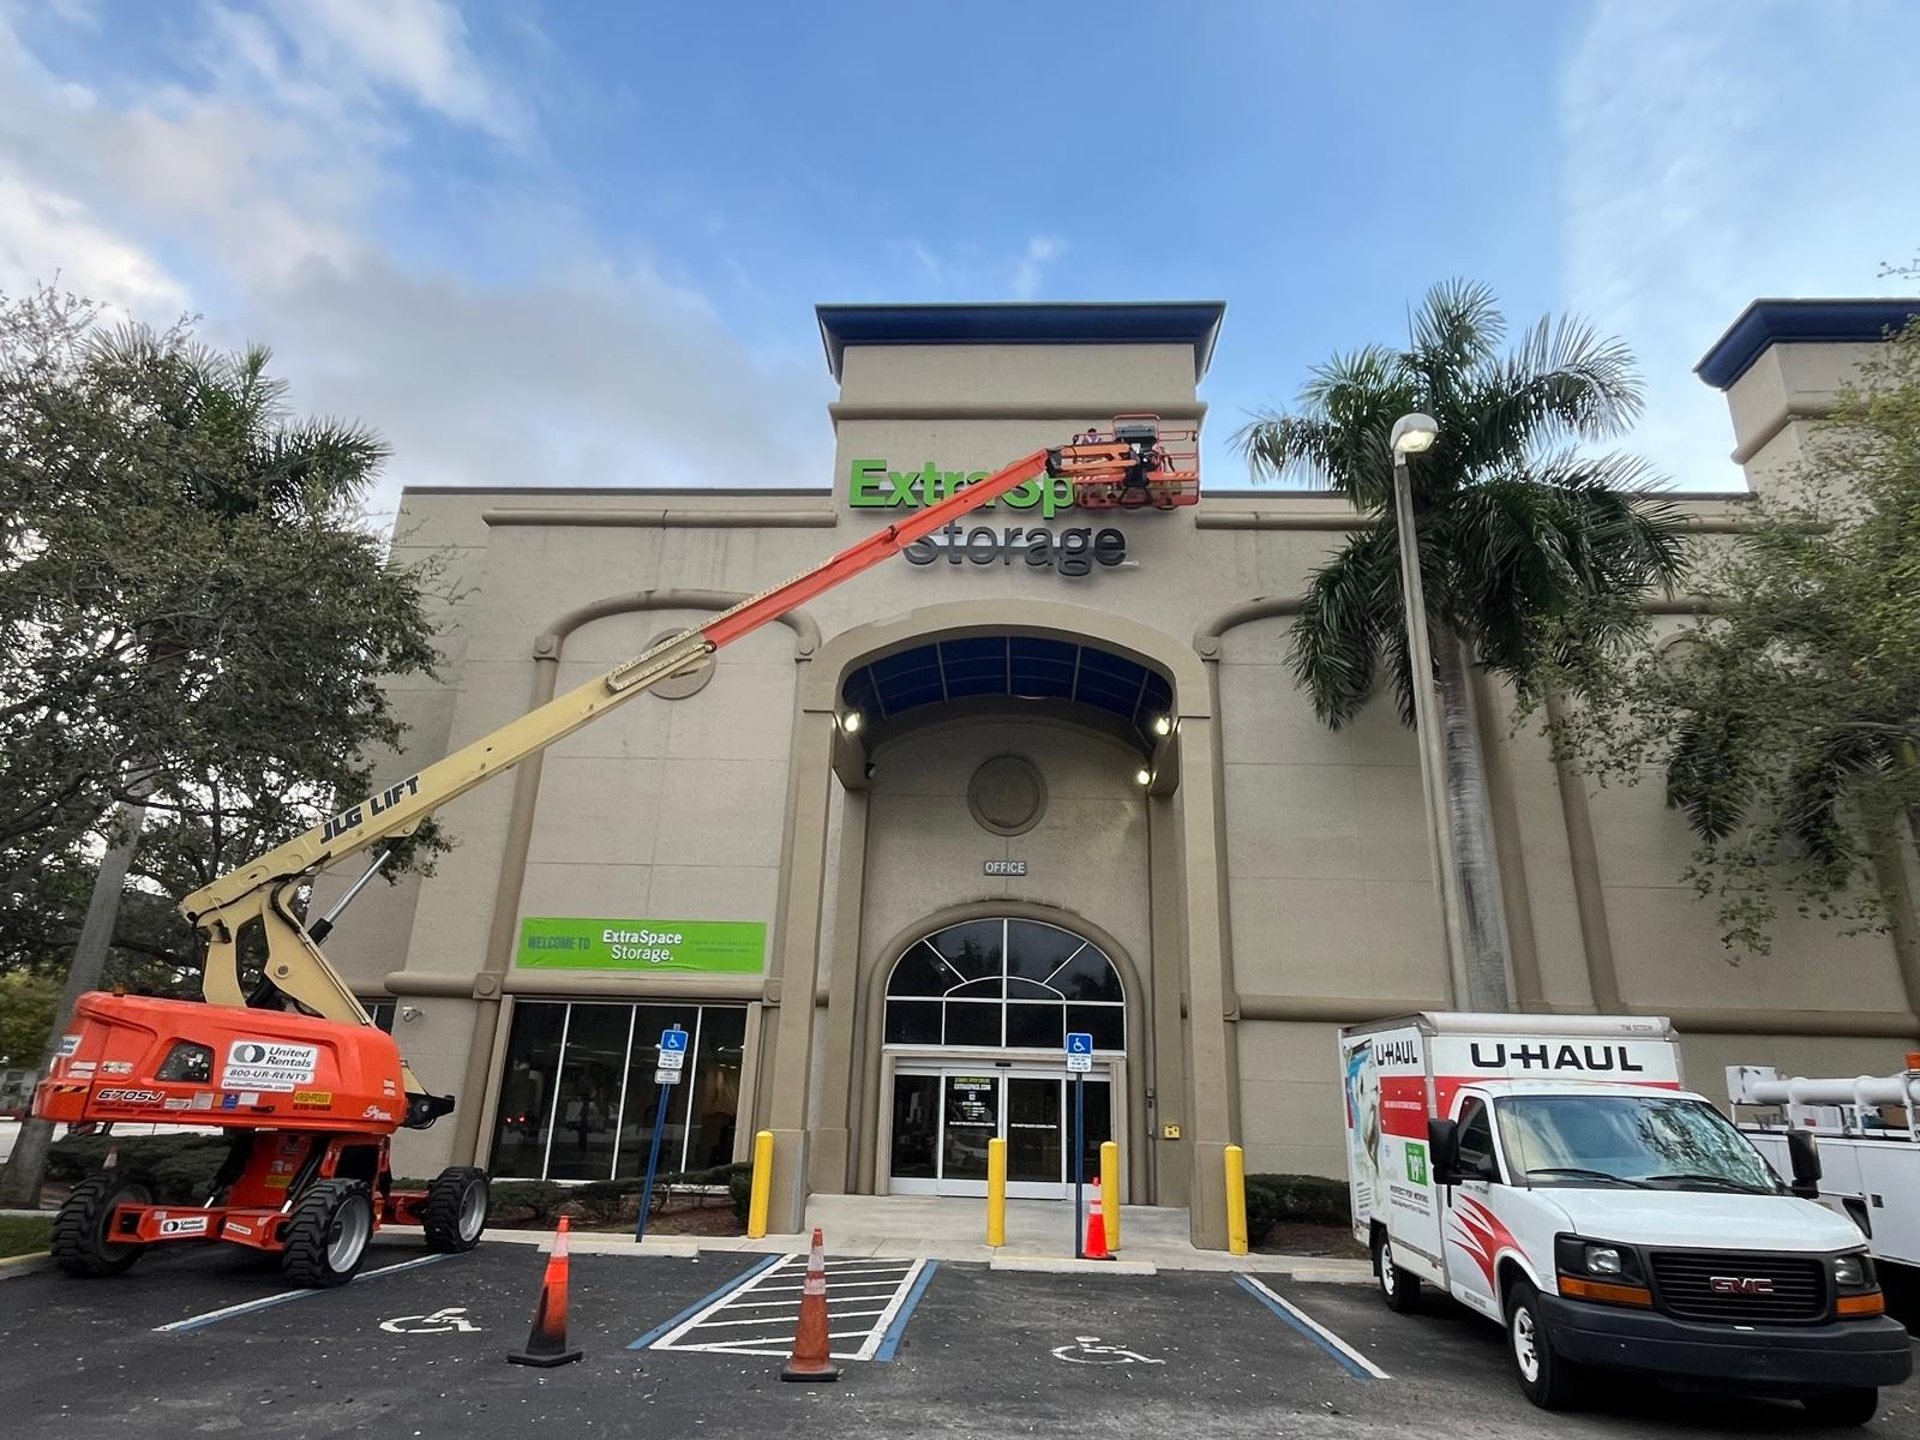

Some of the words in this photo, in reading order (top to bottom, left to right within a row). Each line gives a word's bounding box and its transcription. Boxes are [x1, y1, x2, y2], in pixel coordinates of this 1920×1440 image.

[902, 518, 1126, 576] Storage
[320, 806, 363, 845] JLG
[370, 775, 419, 817] LIFT
[985, 862, 1026, 874] OFFICE
[527, 936, 575, 950] WELCOME
[578, 937, 591, 950] TO
[602, 929, 683, 946] ExtraSpace
[269, 1046, 311, 1057] United
[1471, 1043, 1643, 1072] U-HAUL
[265, 1056, 311, 1067] Rentals
[229, 1068, 308, 1081] 800-UR-RENTS
[98, 1088, 164, 1102] 670SJ
[1710, 1276, 1774, 1293] GMC
